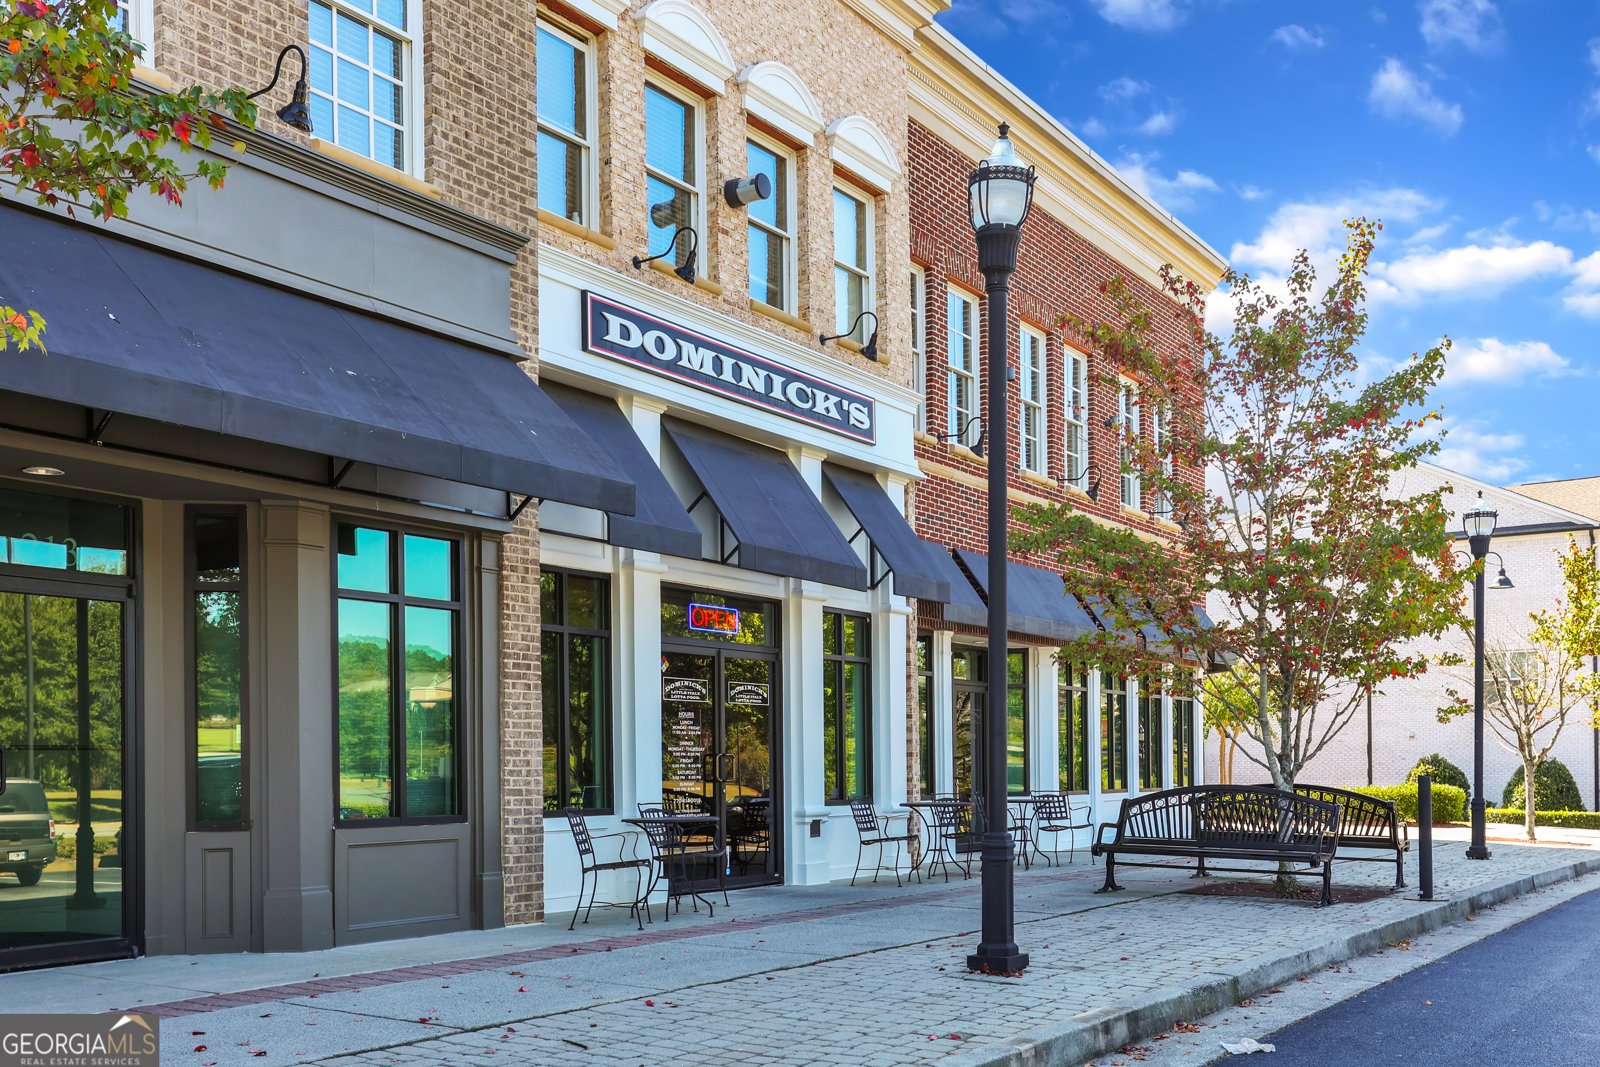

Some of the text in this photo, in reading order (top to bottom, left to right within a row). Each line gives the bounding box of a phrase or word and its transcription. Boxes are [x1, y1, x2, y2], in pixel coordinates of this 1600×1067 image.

[601, 311, 871, 430] DOMINICK'S
[691, 607, 737, 630] OPEN
[665, 680, 707, 695] DOMINICK'S
[730, 685, 768, 698] DOMINICK'S
